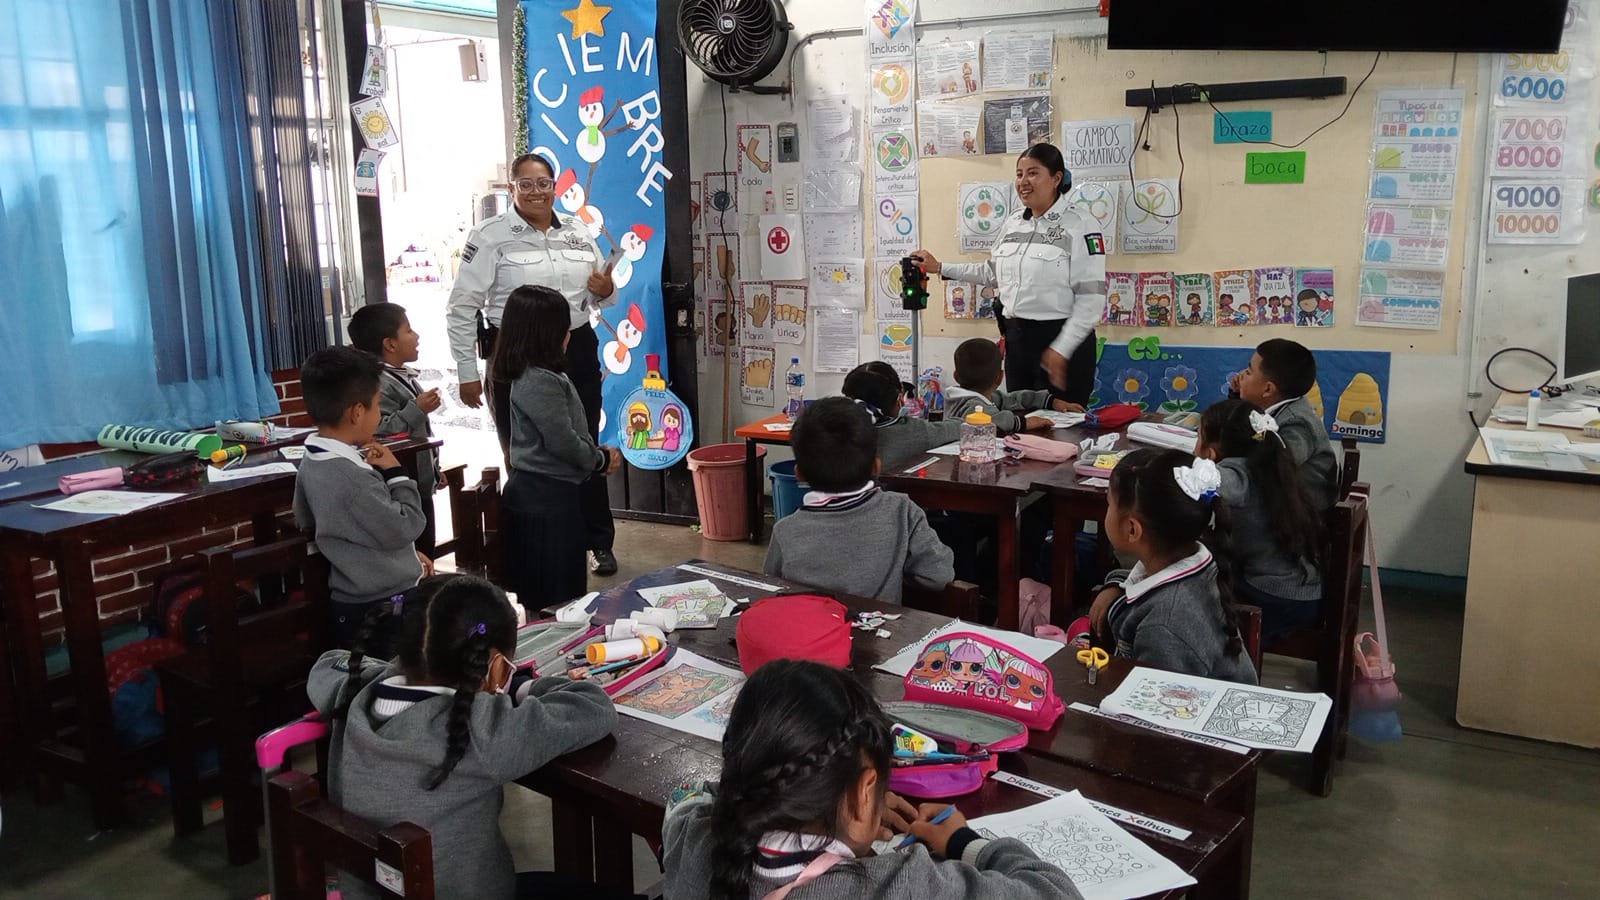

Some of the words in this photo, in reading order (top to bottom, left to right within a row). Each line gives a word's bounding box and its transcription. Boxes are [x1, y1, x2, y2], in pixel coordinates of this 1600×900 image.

[871, 42, 911, 54] Inclusión
[1502, 76, 1565, 100] 6000
[1076, 125, 1120, 148] CAMPOS
[1219, 118, 1269, 137] brazo
[1502, 118, 1563, 140] 7000
[1071, 146, 1127, 167] FORMATIVOS
[1251, 155, 1297, 175] boca
[1497, 146, 1561, 167] 8000
[1497, 186, 1561, 208] 9000
[1496, 214, 1559, 233] 10000
[1266, 273, 1283, 281] HAZ
[645, 390, 667, 399] FELIZ
[1331, 423, 1384, 437] Domingo
[1006, 776, 1041, 792] Diana
[1126, 814, 1173, 835] Xelhua
